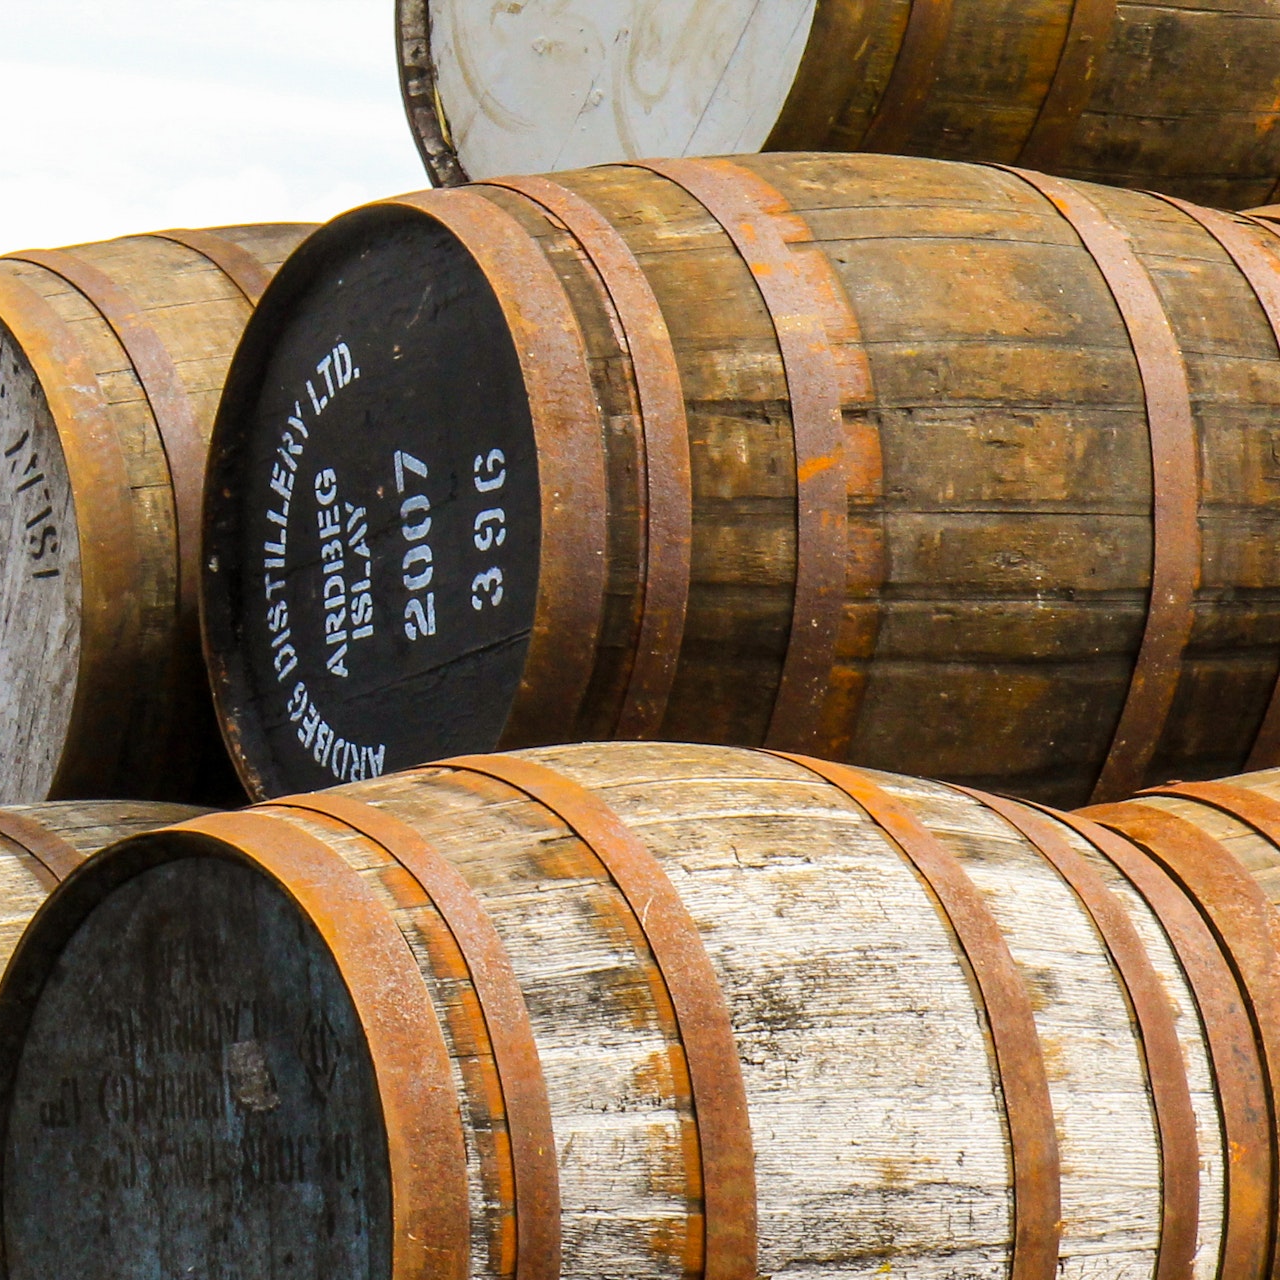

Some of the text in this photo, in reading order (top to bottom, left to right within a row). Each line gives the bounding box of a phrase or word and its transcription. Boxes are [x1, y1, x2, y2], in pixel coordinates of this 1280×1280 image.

[265, 343, 386, 781] ARDBEG DISTILLERY LTD.
[314, 468, 348, 678] ARDBEG
[346, 502, 374, 639] ISLAY
[394, 450, 436, 641] 2007
